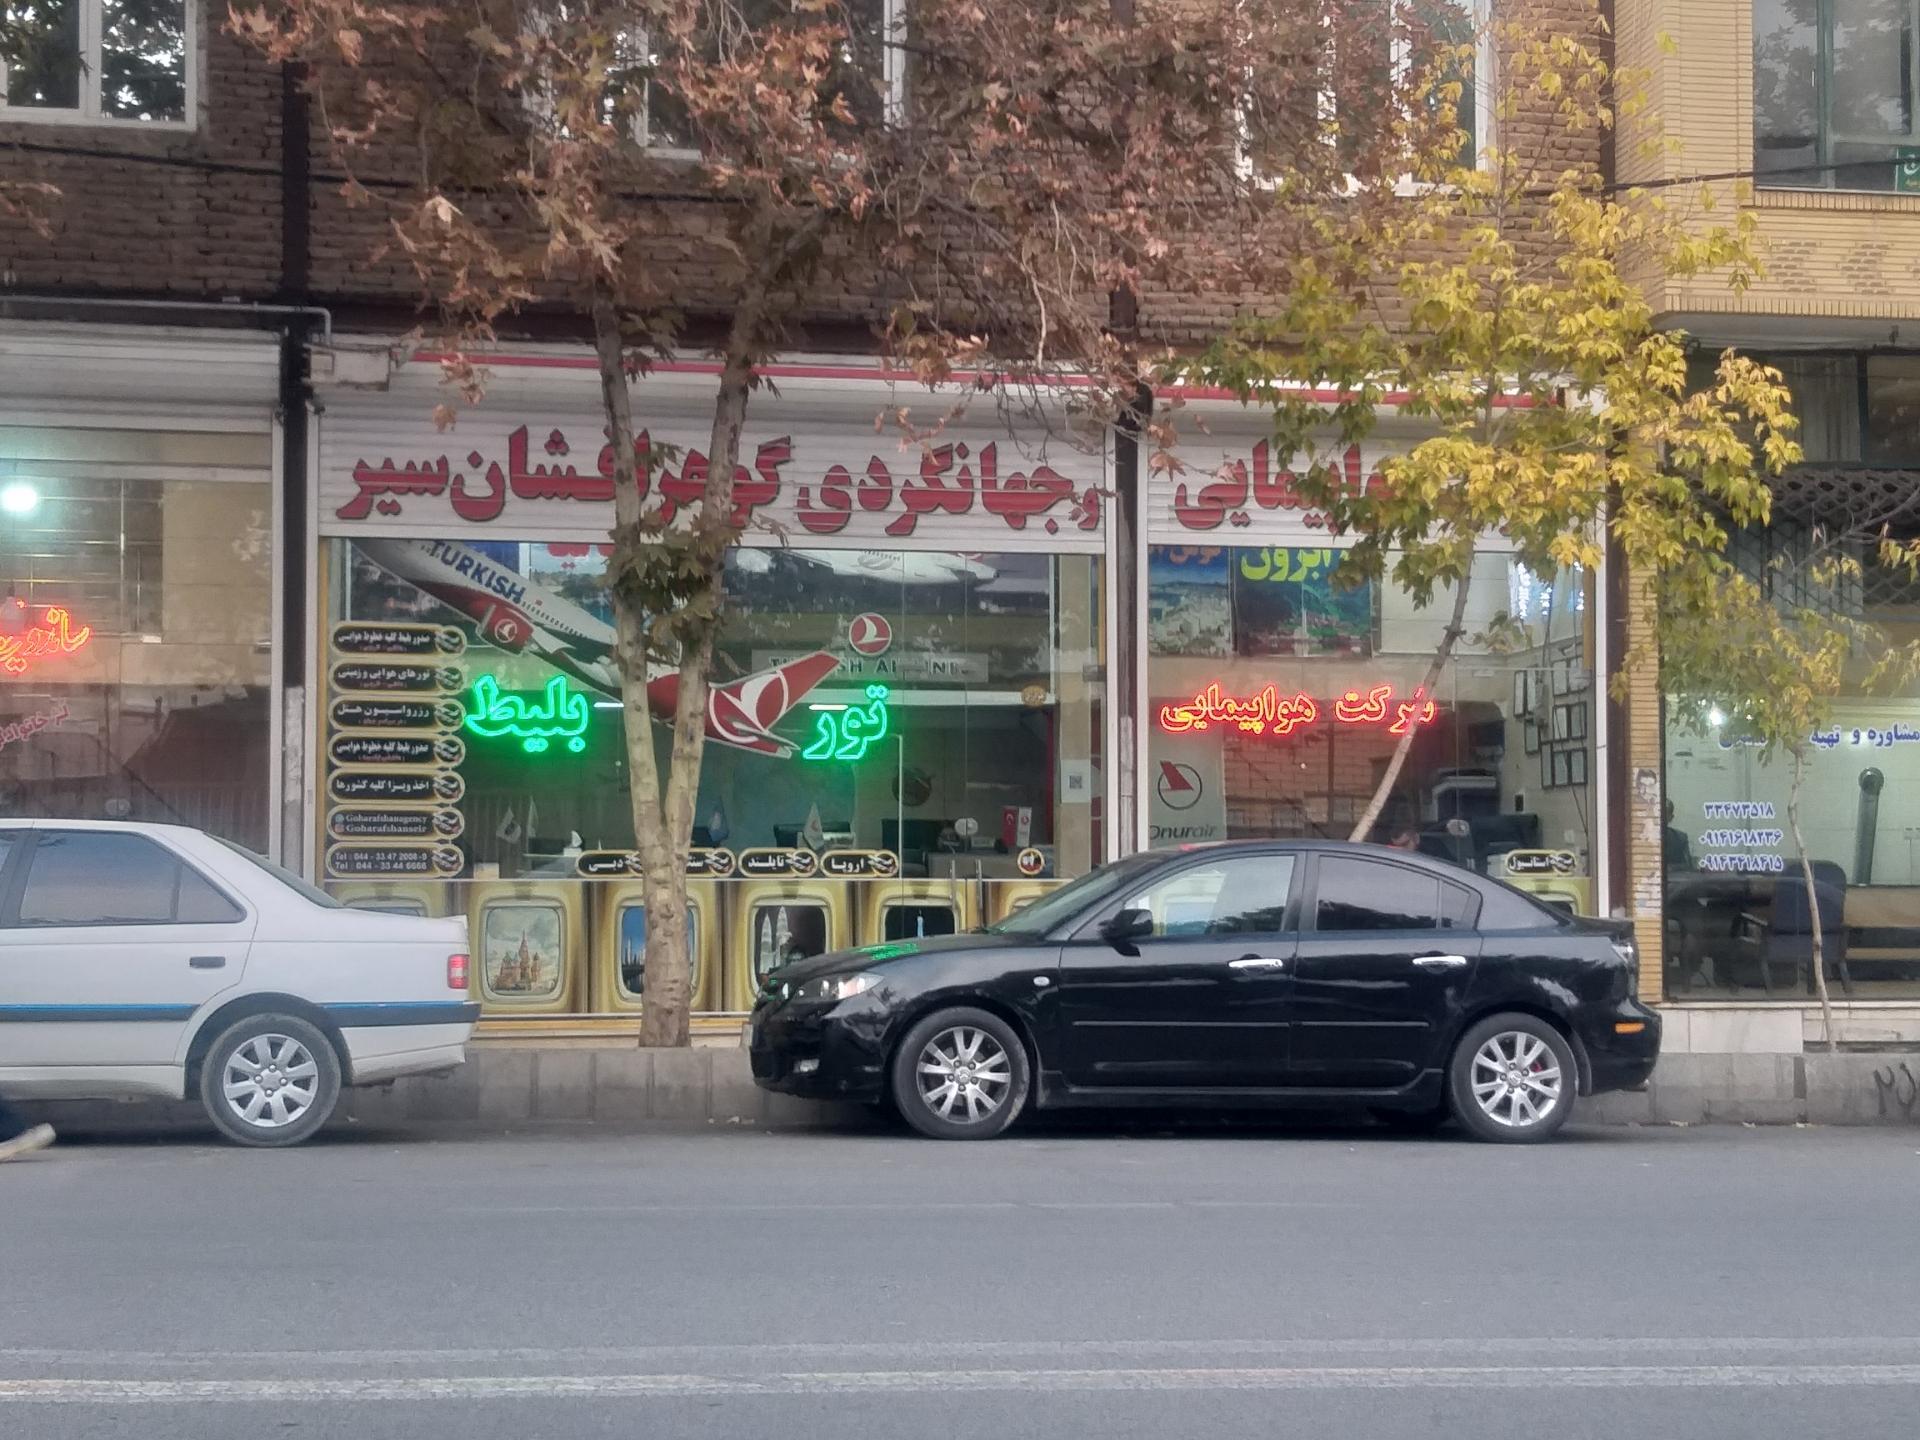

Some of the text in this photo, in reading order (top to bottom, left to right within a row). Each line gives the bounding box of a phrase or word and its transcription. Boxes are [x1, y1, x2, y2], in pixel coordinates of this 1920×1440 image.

[335, 454, 450, 520] سیر
[429, 540, 526, 605] TURKISH
[463, 674, 589, 753] بلیط
[802, 684, 889, 761] تور
[1159, 682, 1318, 735] هواپیمایی
[1850, 727, 1861, 745] و
[588, 858, 625, 873] دبی
[747, 855, 786, 869] تایلند
